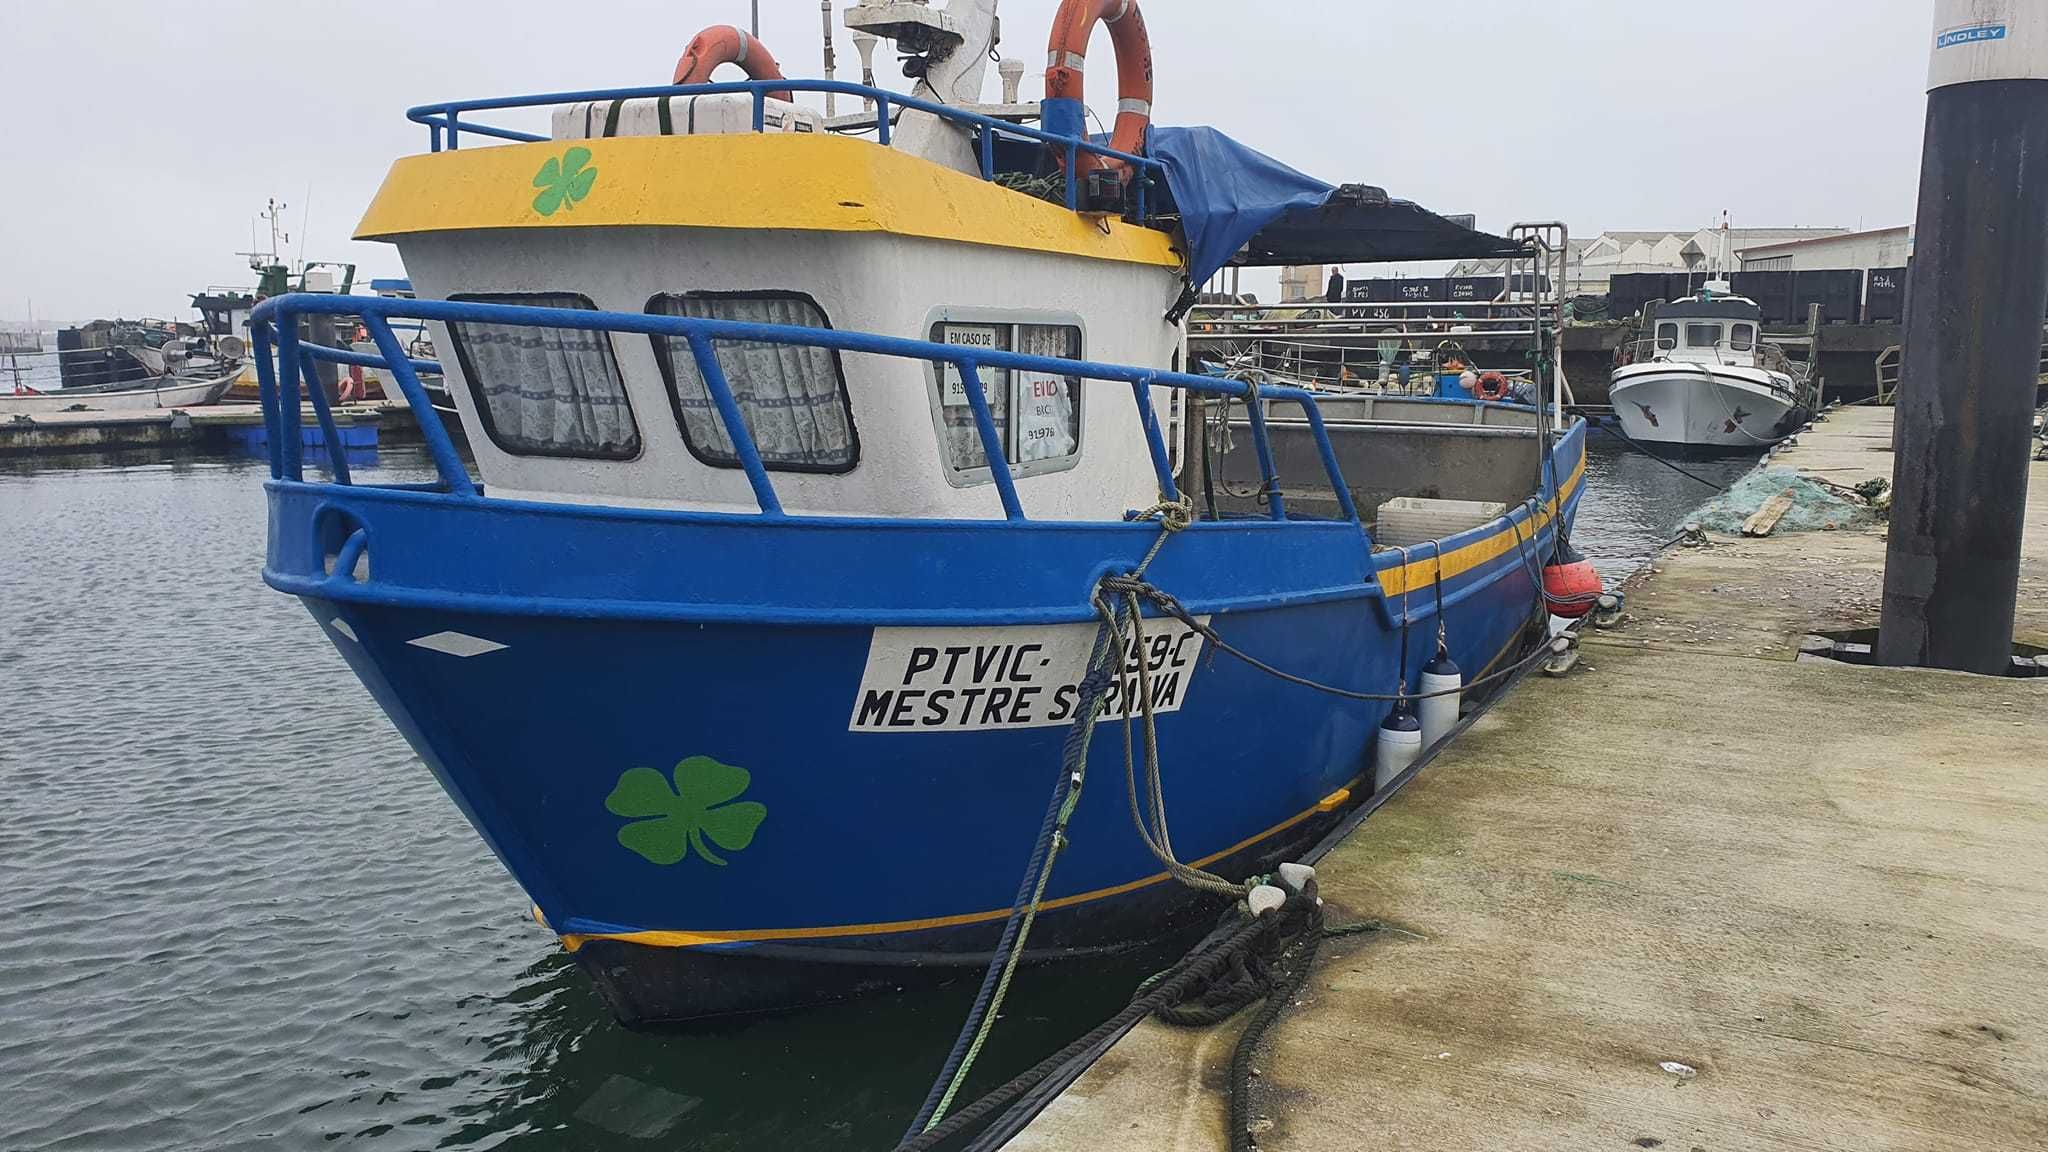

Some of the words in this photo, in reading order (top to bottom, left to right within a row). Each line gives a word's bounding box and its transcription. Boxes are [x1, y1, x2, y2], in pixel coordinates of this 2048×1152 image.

[950, 332, 961, 344] EM
[962, 332, 981, 345] CASO
[982, 334, 991, 345] DE
[855, 686, 1042, 727] MESTRE
